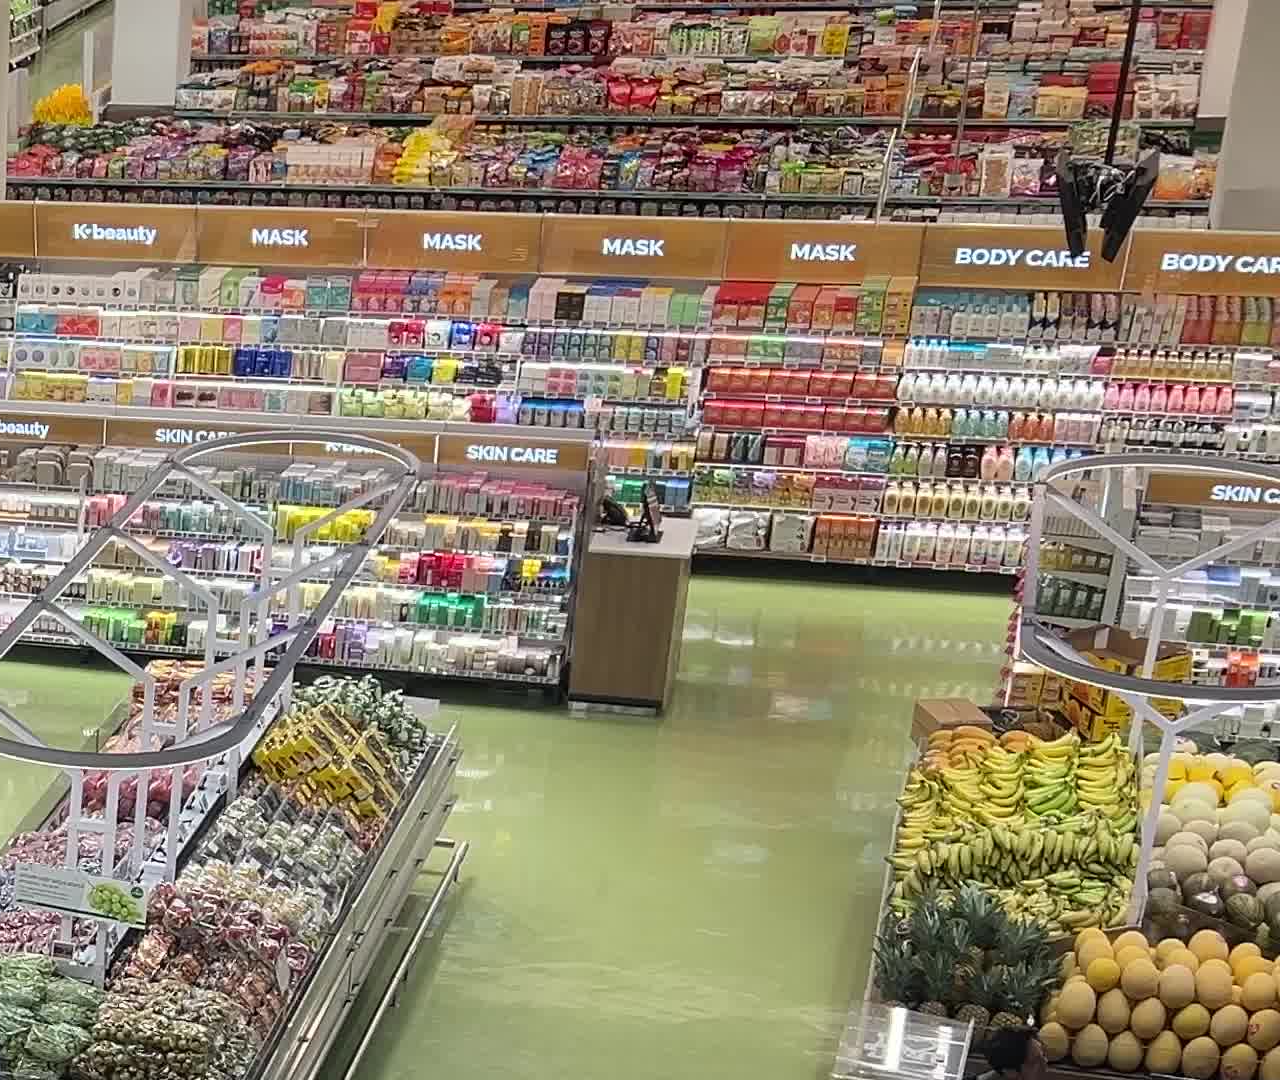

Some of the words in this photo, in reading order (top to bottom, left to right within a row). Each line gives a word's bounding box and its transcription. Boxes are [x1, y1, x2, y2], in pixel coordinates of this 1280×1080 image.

[251, 228, 308, 246] MASK
[422, 233, 482, 251] MASK
[602, 238, 665, 256] MASK
[789, 243, 857, 261] MASK
[954, 247, 1024, 266] BODY
[1025, 250, 1091, 268] CARE
[1161, 253, 1234, 272] BODY
[154, 428, 193, 444] SKIN
[466, 445, 509, 462] SKIN
[510, 447, 559, 465] CARE
[1211, 484, 1262, 503] SKIN
